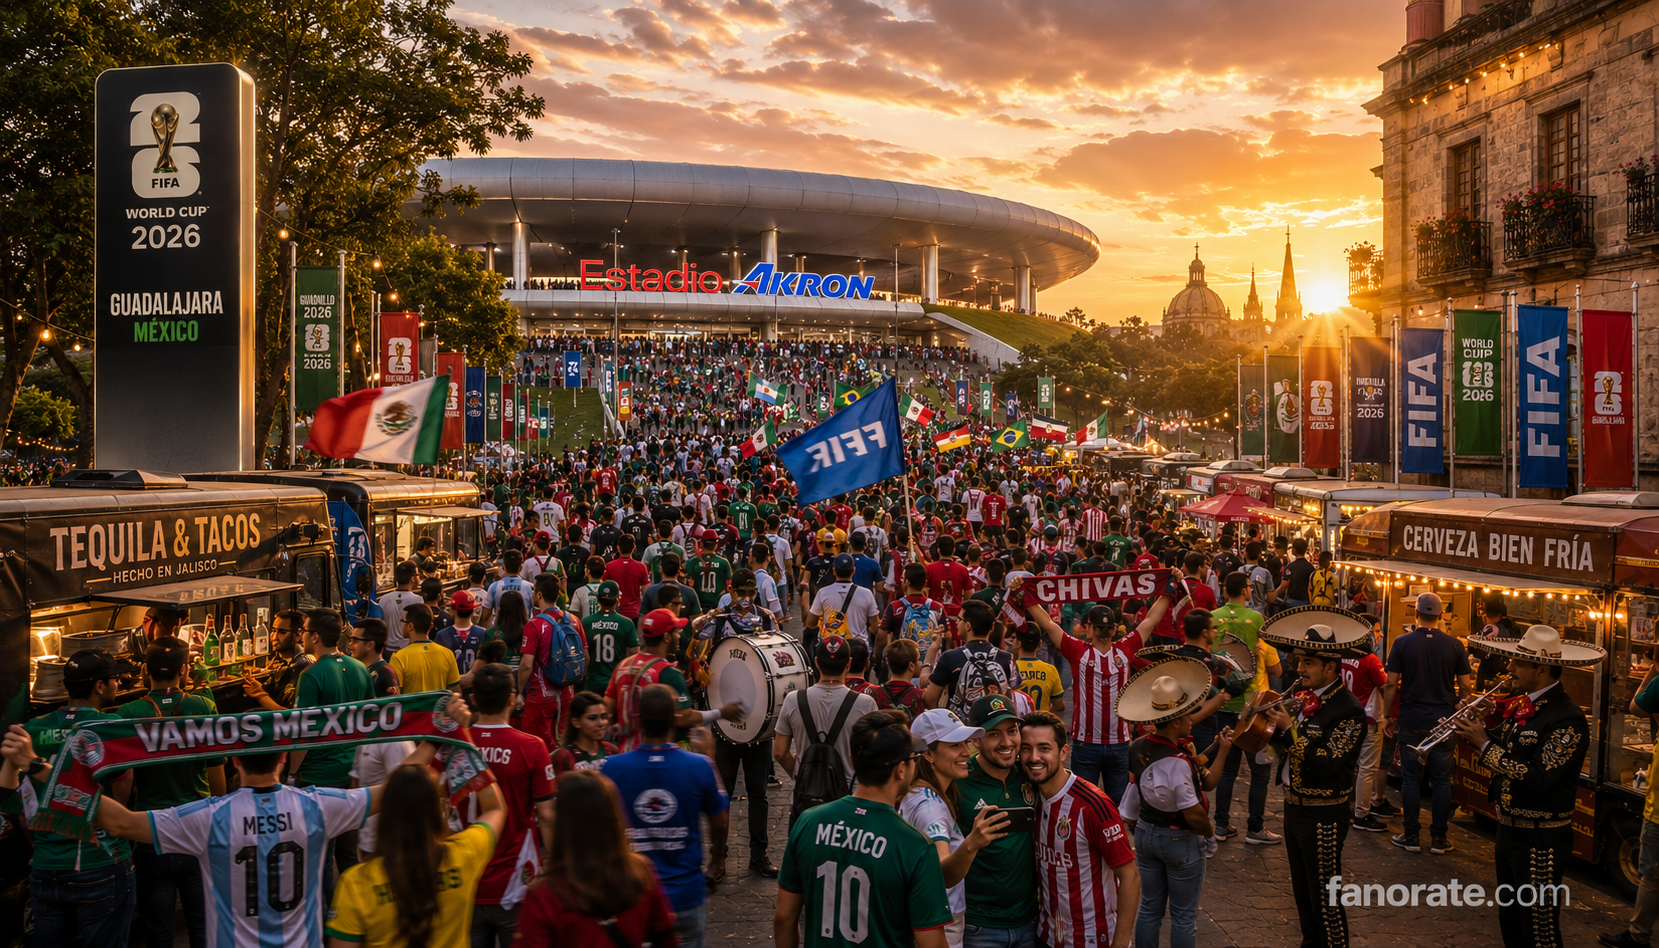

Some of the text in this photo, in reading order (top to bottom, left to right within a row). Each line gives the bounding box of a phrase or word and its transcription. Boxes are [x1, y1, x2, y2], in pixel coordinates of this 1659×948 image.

[151, 178, 180, 188] FIFA
[126, 208, 174, 219] WORLD
[132, 224, 200, 249] 2026
[580, 259, 875, 299] Estadio AKRON
[110, 291, 223, 315] GUADALAJARA
[304, 306, 332, 318] 2026
[134, 317, 198, 342] MÉXICO
[1462, 338, 1494, 348] WORLD
[304, 359, 331, 369] 2026
[1408, 352, 1436, 447] FIFA
[1527, 336, 1560, 457] FIFA
[1356, 408, 1384, 418] 2026
[50, 512, 260, 571] TEQUILA & TACOS
[1403, 524, 1594, 572] CERVEZA BIEN FRÍA
[113, 559, 217, 584] HECHO EN JALISCO
[1036, 573, 1156, 602] CHIVAS
[593, 634, 614, 662] 18
[134, 702, 402, 752] VAMOS MEXICO
[243, 812, 293, 835] MESSI
[815, 820, 887, 859] MÉXICO
[234, 840, 305, 917] 10
[816, 860, 871, 944] 10
